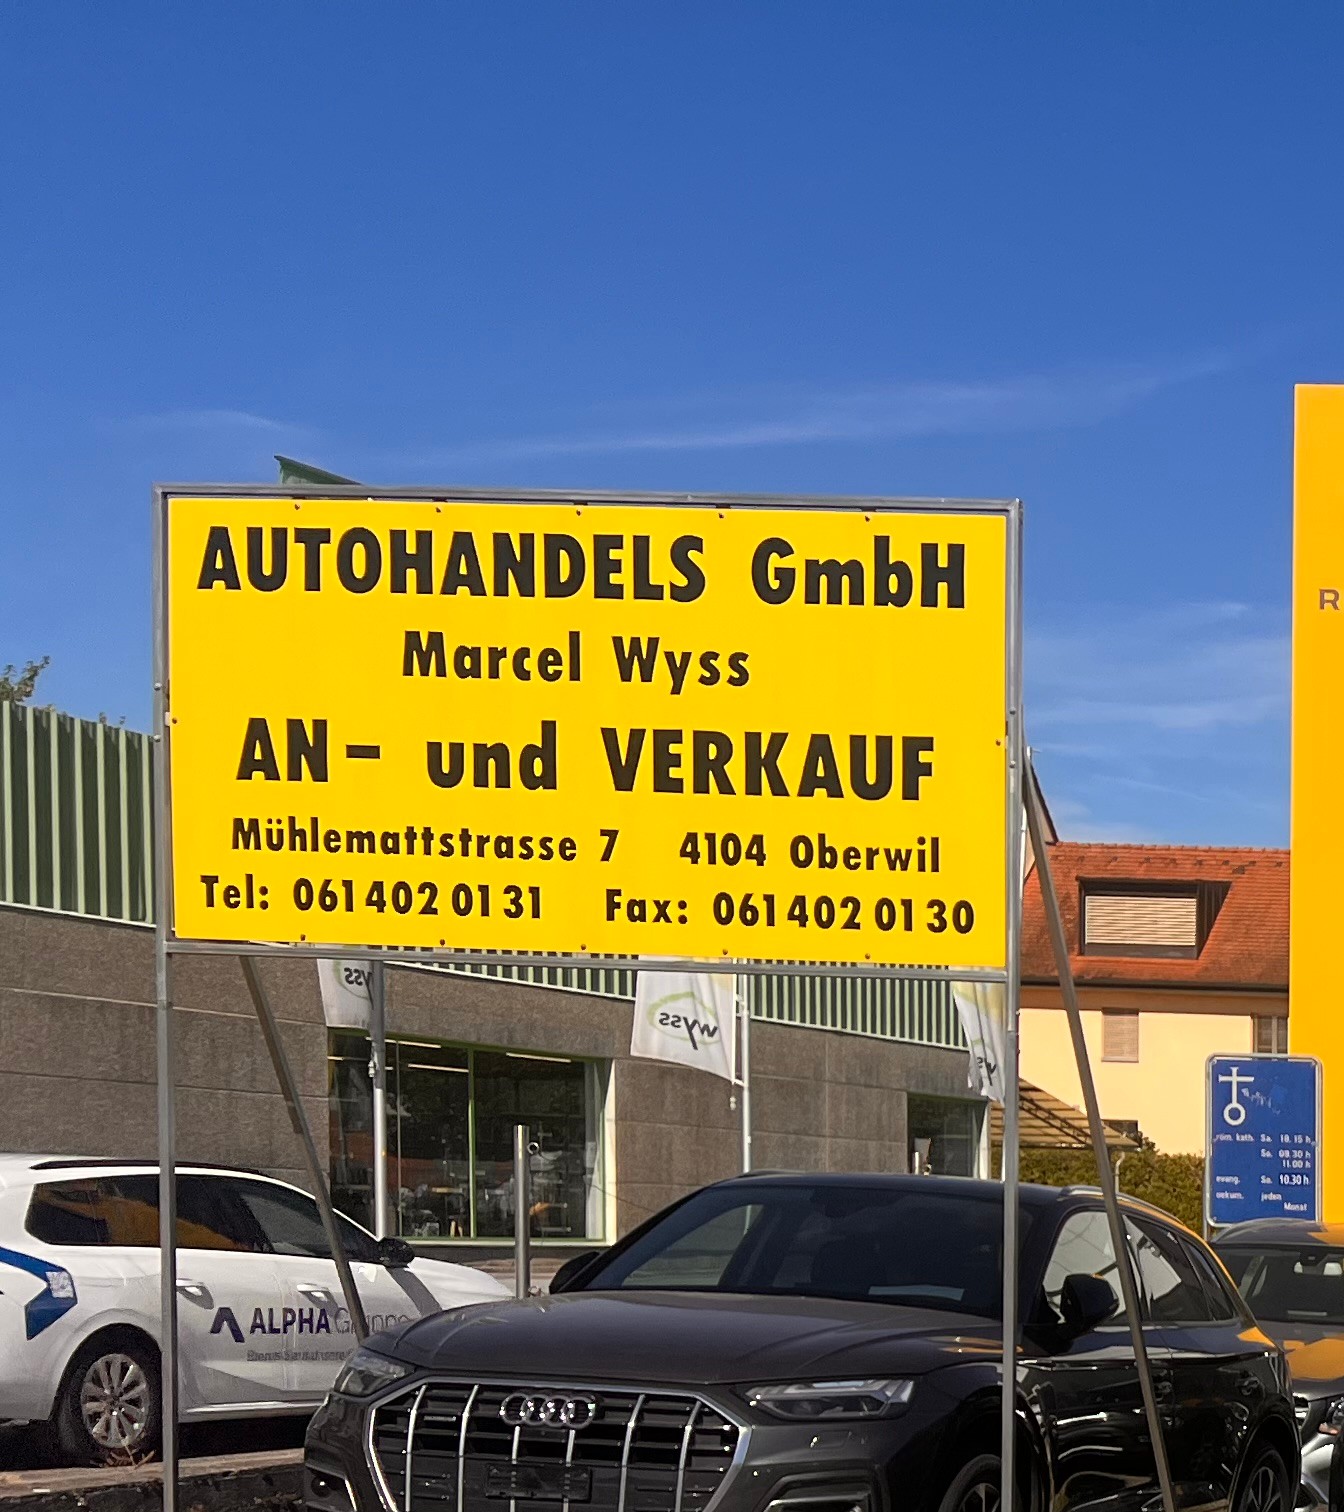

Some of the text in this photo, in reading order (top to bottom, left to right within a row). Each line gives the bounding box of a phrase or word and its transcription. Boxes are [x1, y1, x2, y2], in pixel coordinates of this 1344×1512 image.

[196, 525, 965, 609] AUTOHANDELS GmbH
[402, 630, 750, 696] Marcel Wyss
[235, 717, 934, 801] AN- und VERKAUF
[231, 815, 940, 873] Mühlemattstrasse 7 4104 Oberwil
[200, 873, 269, 911] Tel:
[605, 888, 688, 925] Fax:
[1280, 1174, 1302, 1185] 10.30
[1284, 1202, 1308, 1211] Monat
